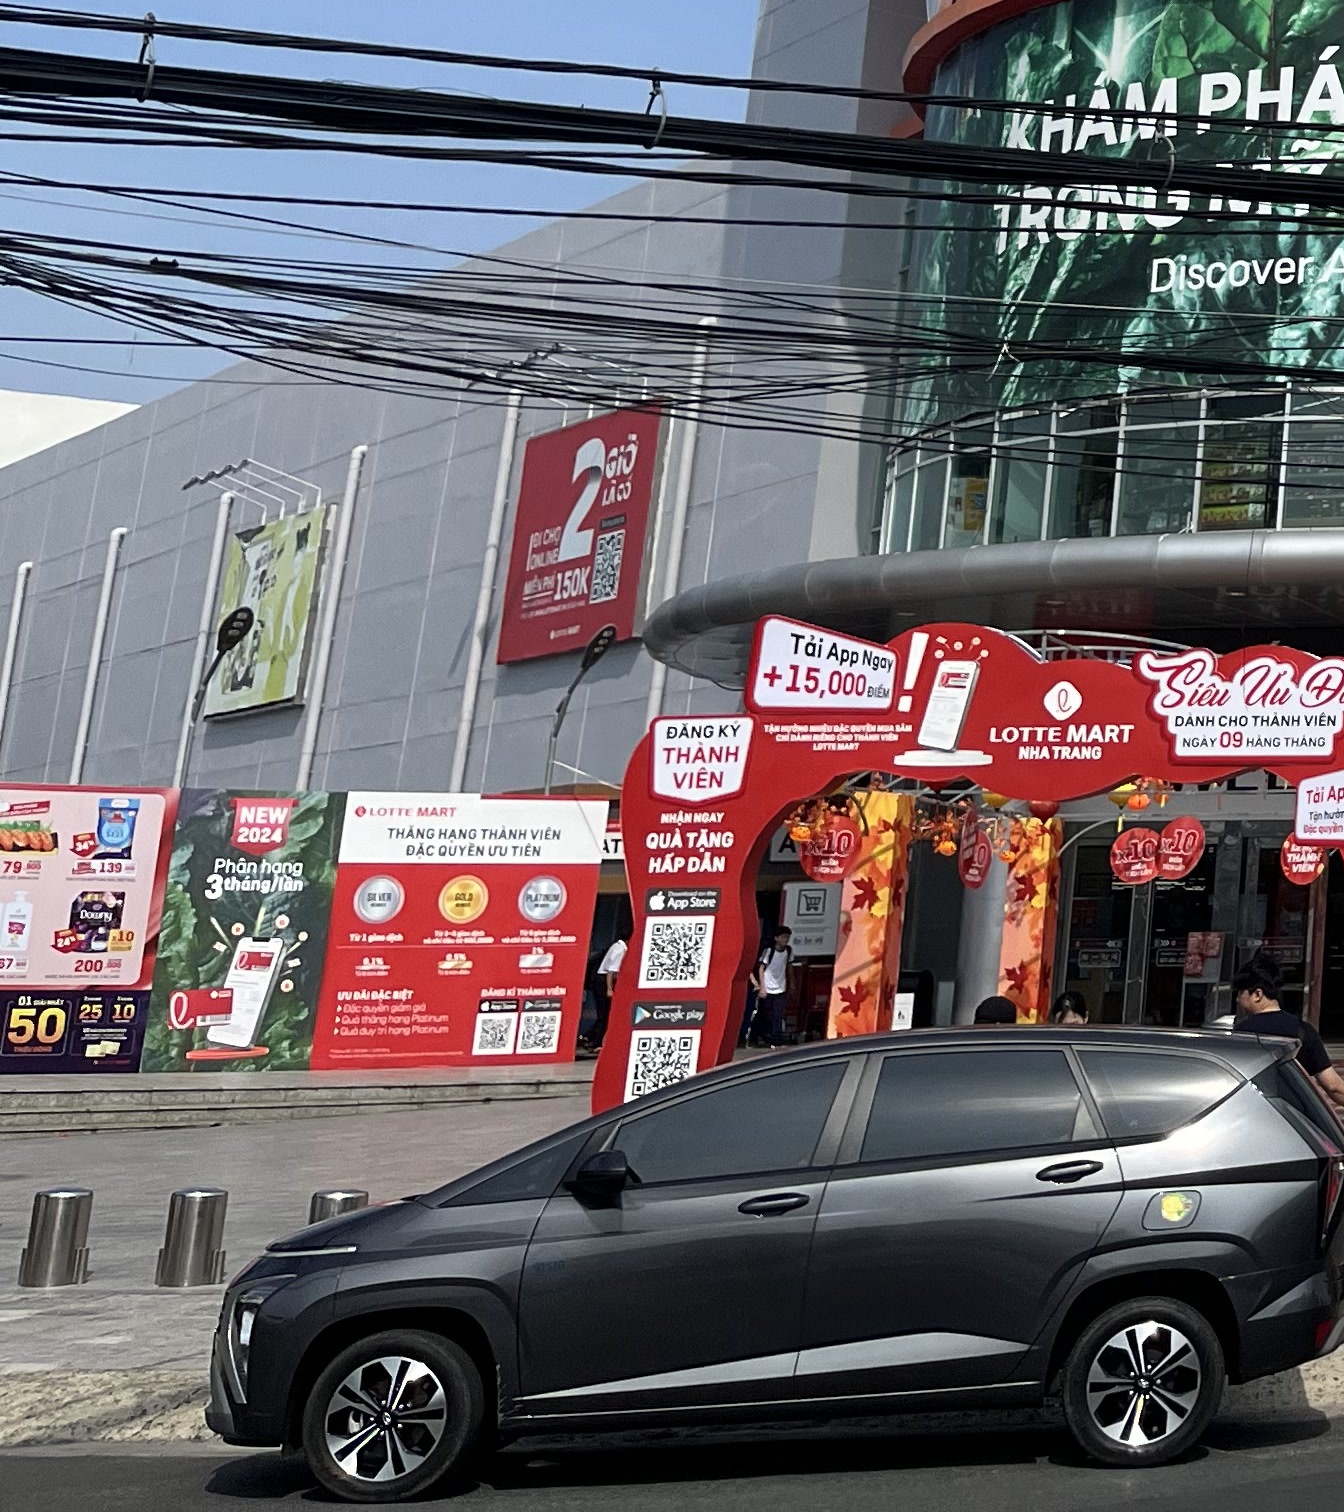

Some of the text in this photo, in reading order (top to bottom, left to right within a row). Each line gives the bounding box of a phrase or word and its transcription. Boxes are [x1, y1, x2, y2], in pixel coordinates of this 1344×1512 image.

[1150, 254, 1317, 294] Discover
[558, 437, 606, 563] 2
[554, 566, 592, 601] 150K
[790, 633, 894, 673] Tải App Ngay
[763, 664, 867, 699] +15,000
[1147, 658, 1232, 709] Siêu
[1174, 711, 1337, 728] DÀNH CHO THÀNH VIÊN
[665, 719, 742, 740] ĐĂNG KÝ
[989, 724, 1135, 744] LOTTE MART
[1182, 731, 1326, 749] NGÀY 09 HÀNG THÁNG
[662, 741, 740, 765] THÀNH
[1018, 745, 1103, 760] NHA TRANG
[673, 767, 725, 790] VIÊN
[1306, 786, 1325, 805] Tải
[239, 806, 289, 825] NEW
[368, 806, 457, 818] LOTTE MART
[660, 810, 725, 826] NHẬN NGAY
[237, 826, 284, 844] 2024
[387, 824, 562, 843] THĂNG HẠNG THÀNH VIÊN
[645, 828, 735, 853] QUÀ TẶNG
[1157, 828, 1200, 856] x10
[405, 840, 542, 860] ĐẶC QUYỀN ƯU TIÊN
[3, 860, 23, 874] 79
[99, 862, 122, 874] 139
[214, 857, 258, 874] Phân
[648, 851, 726, 874] HẤP DẪN
[204, 873, 224, 900] 3
[454, 892, 473, 902] GOLD
[667, 896, 717, 910] App Store
[80, 909, 113, 923] Downy
[74, 959, 104, 973] 200
[18, 996, 32, 1006] 01
[79, 1004, 103, 1020] 25
[112, 1004, 136, 1020] 10
[411, 1013, 449, 1024] Platinum
[653, 1009, 705, 1023] Google play
[7, 1007, 67, 1045] 50
[411, 1024, 449, 1035] Platinum
